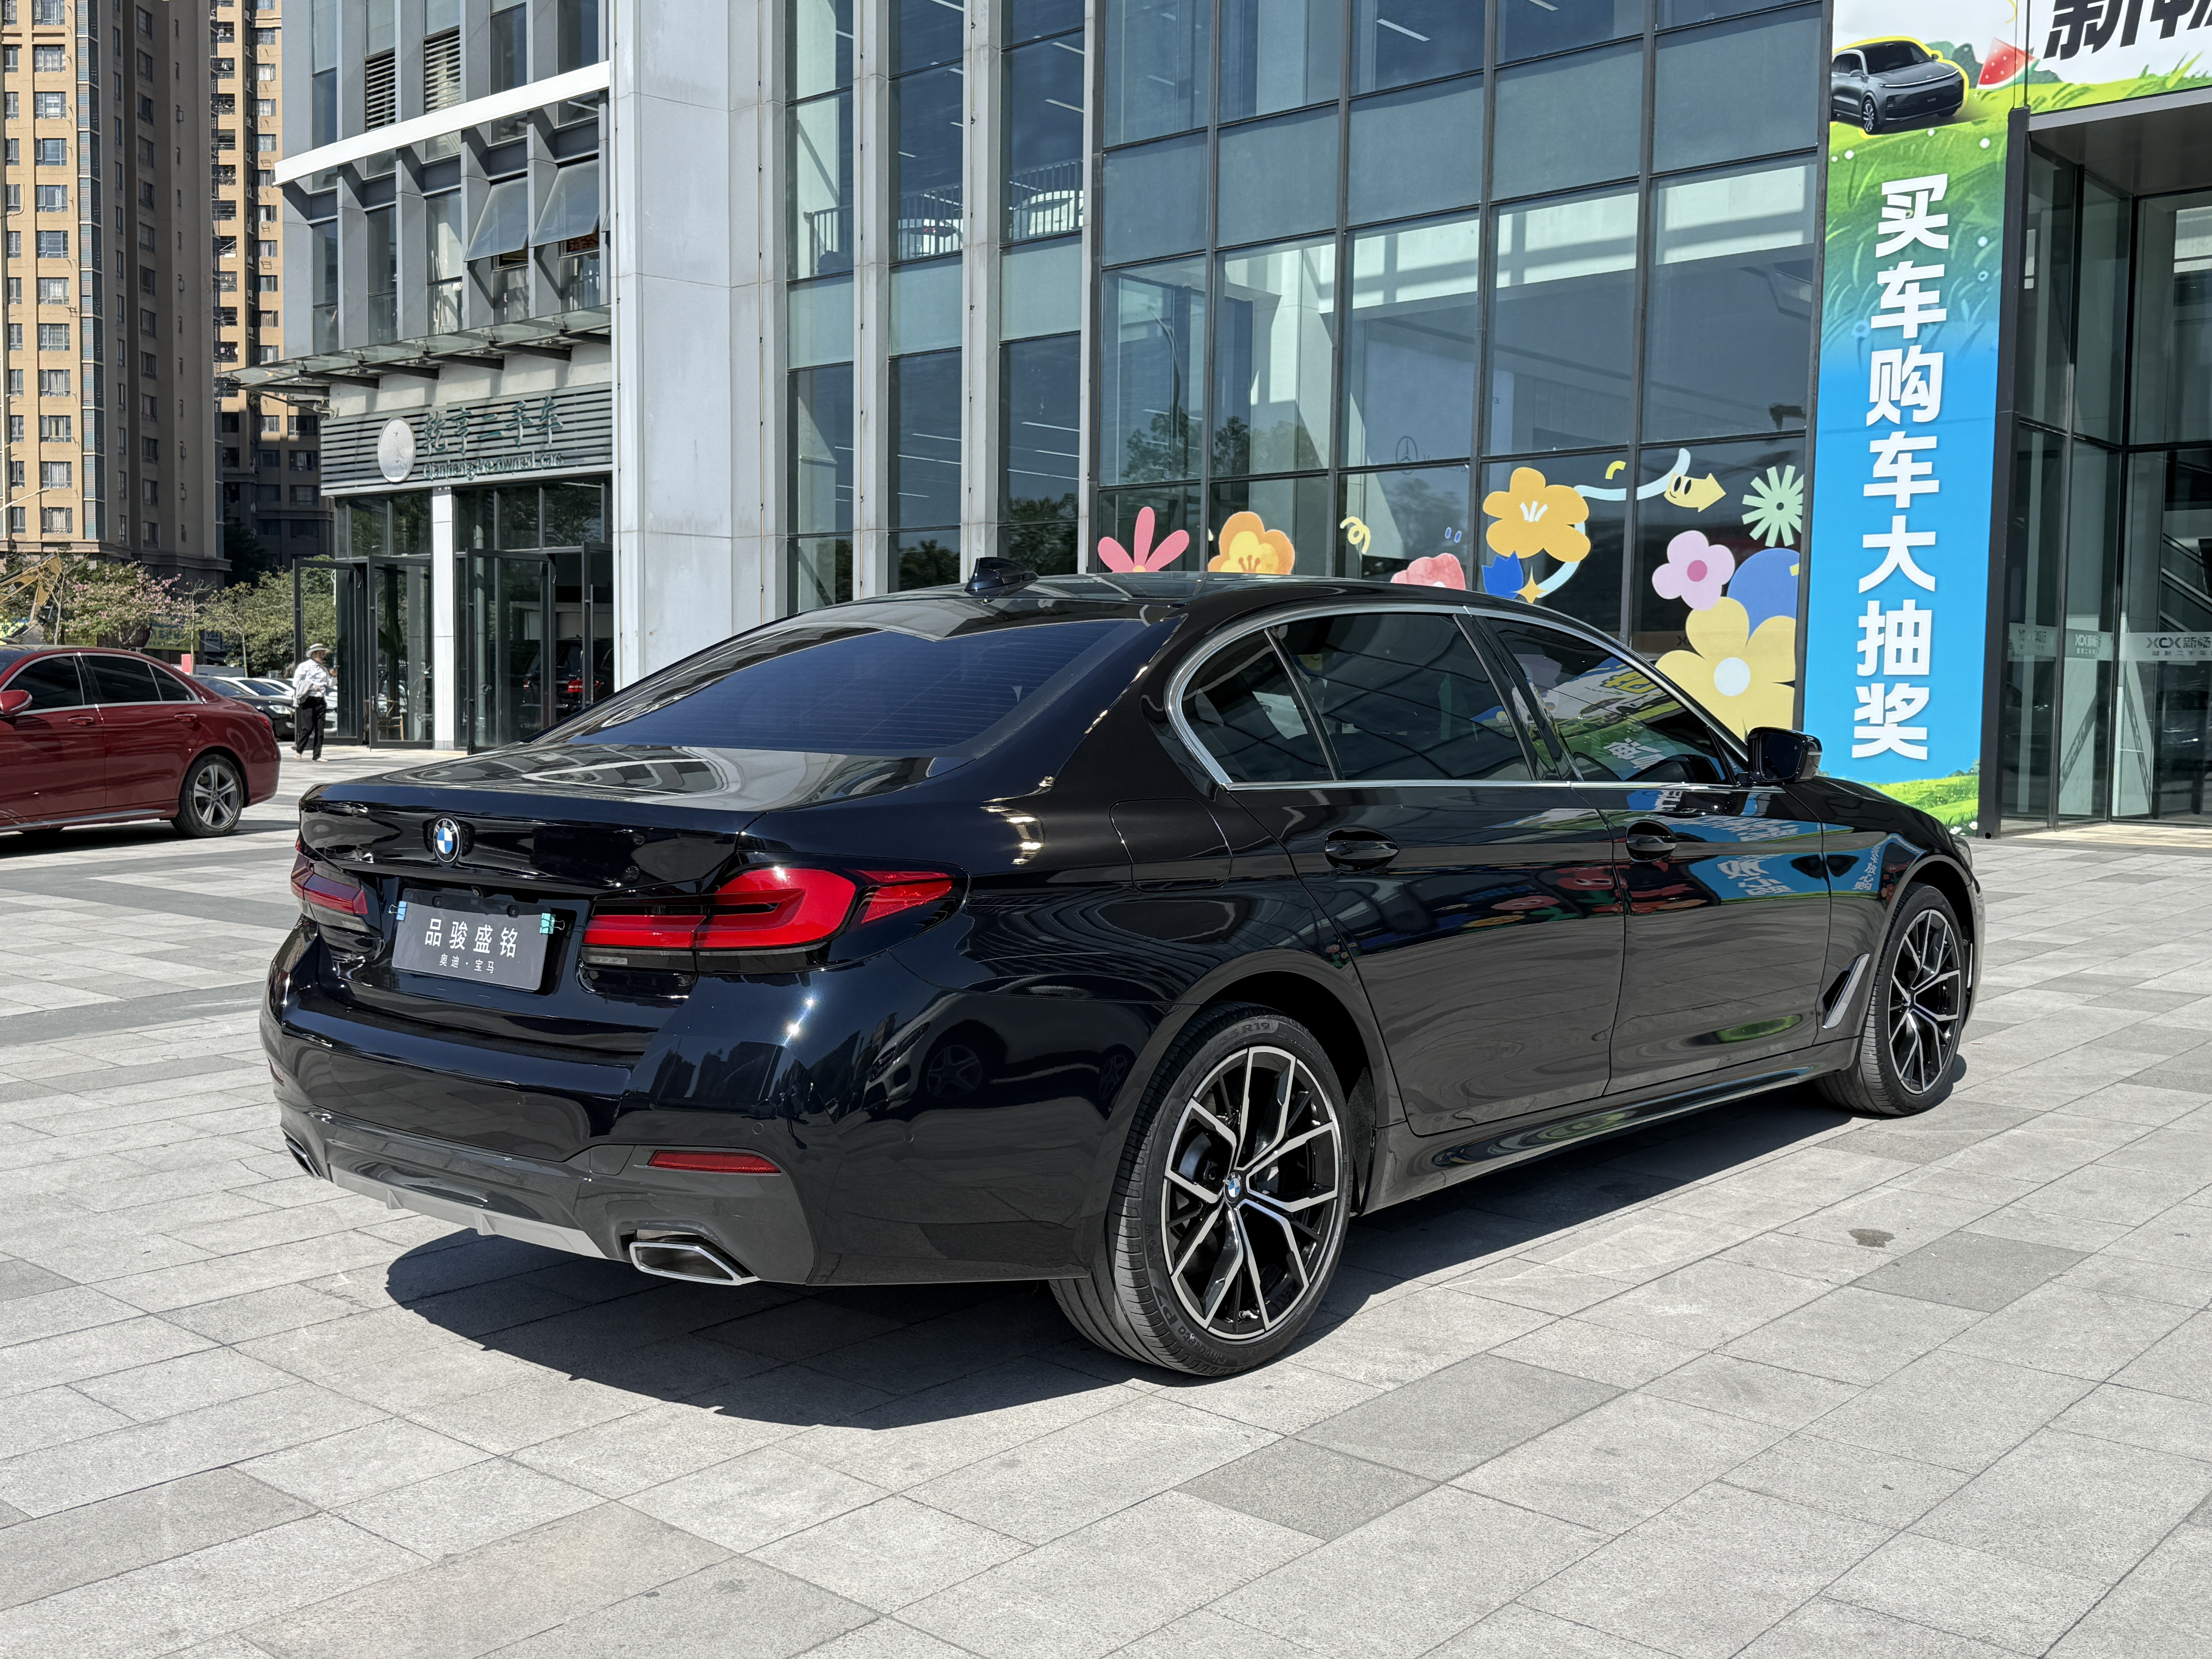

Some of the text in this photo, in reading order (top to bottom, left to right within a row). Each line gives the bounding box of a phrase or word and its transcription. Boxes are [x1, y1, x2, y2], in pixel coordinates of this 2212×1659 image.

[422, 395, 564, 456] 乾亨二手车
[541, 453, 564, 467] cars
[1851, 173, 1949, 760] 买车购车大抽奖
[424, 918, 519, 958] 品骏盛铭
[439, 953, 495, 974] 奥迪·宝马
[1242, 1022, 1271, 1034] R19
[1153, 1285, 1178, 1326] P7
